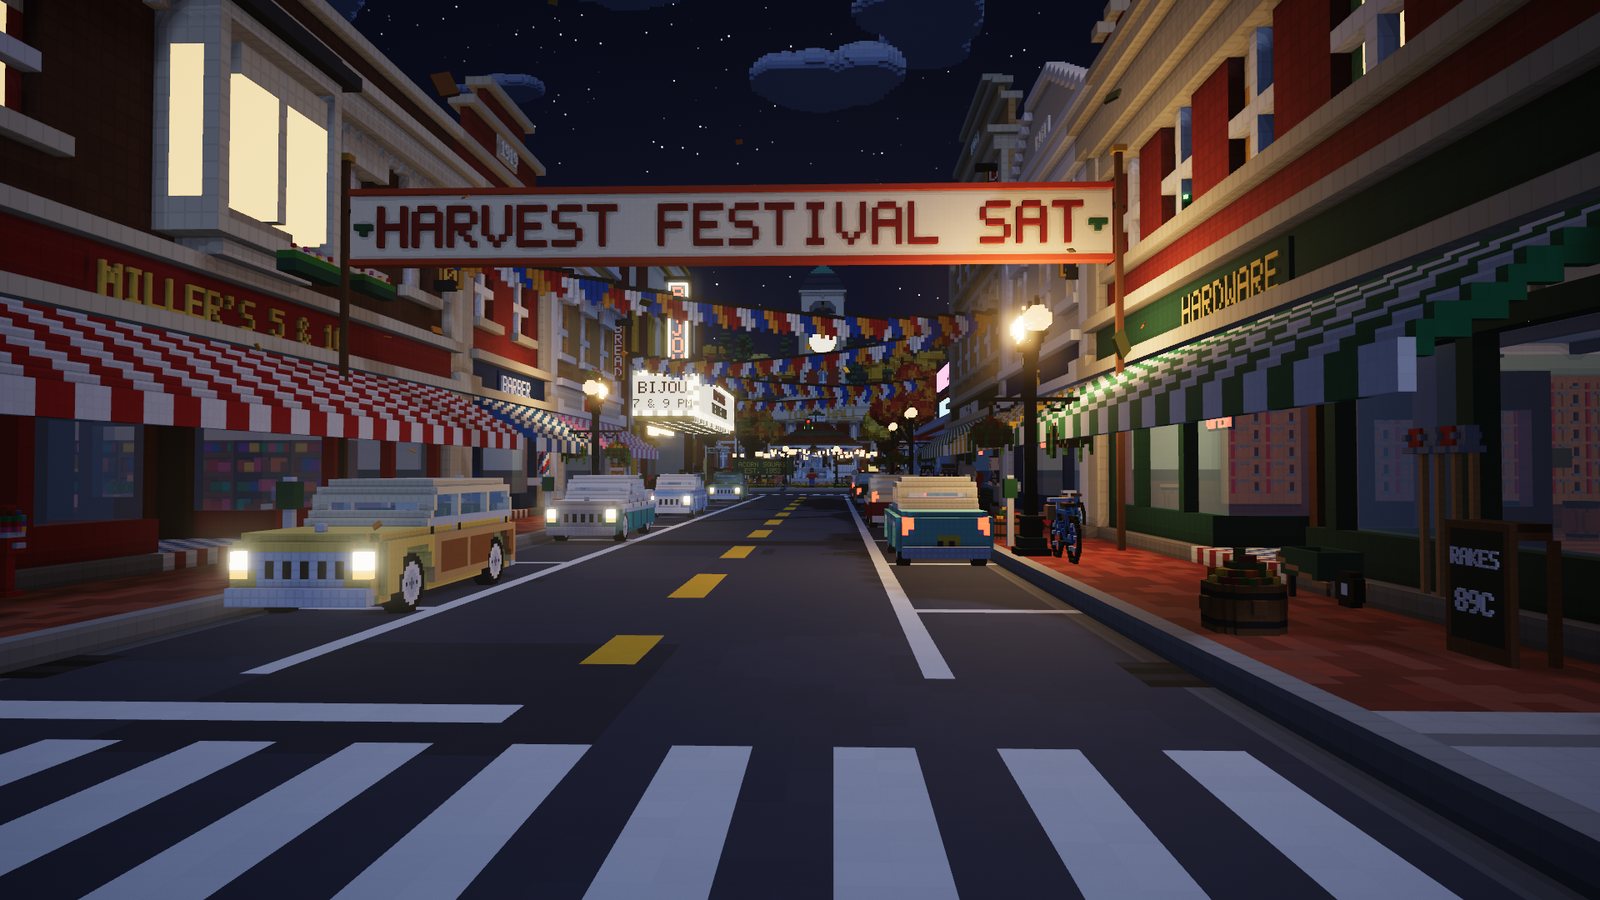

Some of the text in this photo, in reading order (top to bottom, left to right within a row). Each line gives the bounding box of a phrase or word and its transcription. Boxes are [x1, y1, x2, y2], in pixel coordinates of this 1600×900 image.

[376, 199, 1084, 249] HARVEST FESTIVAL SAT
[1181, 250, 1279, 326] HARDWARE
[97, 258, 256, 332] MILLER'S
[268, 307, 286, 339] 5
[296, 316, 312, 346] &
[501, 375, 532, 398] BARBER
[638, 381, 687, 394] BIJOU
[633, 398, 693, 408] 7 & 9 PM
[1450, 545, 1500, 570] RAKES
